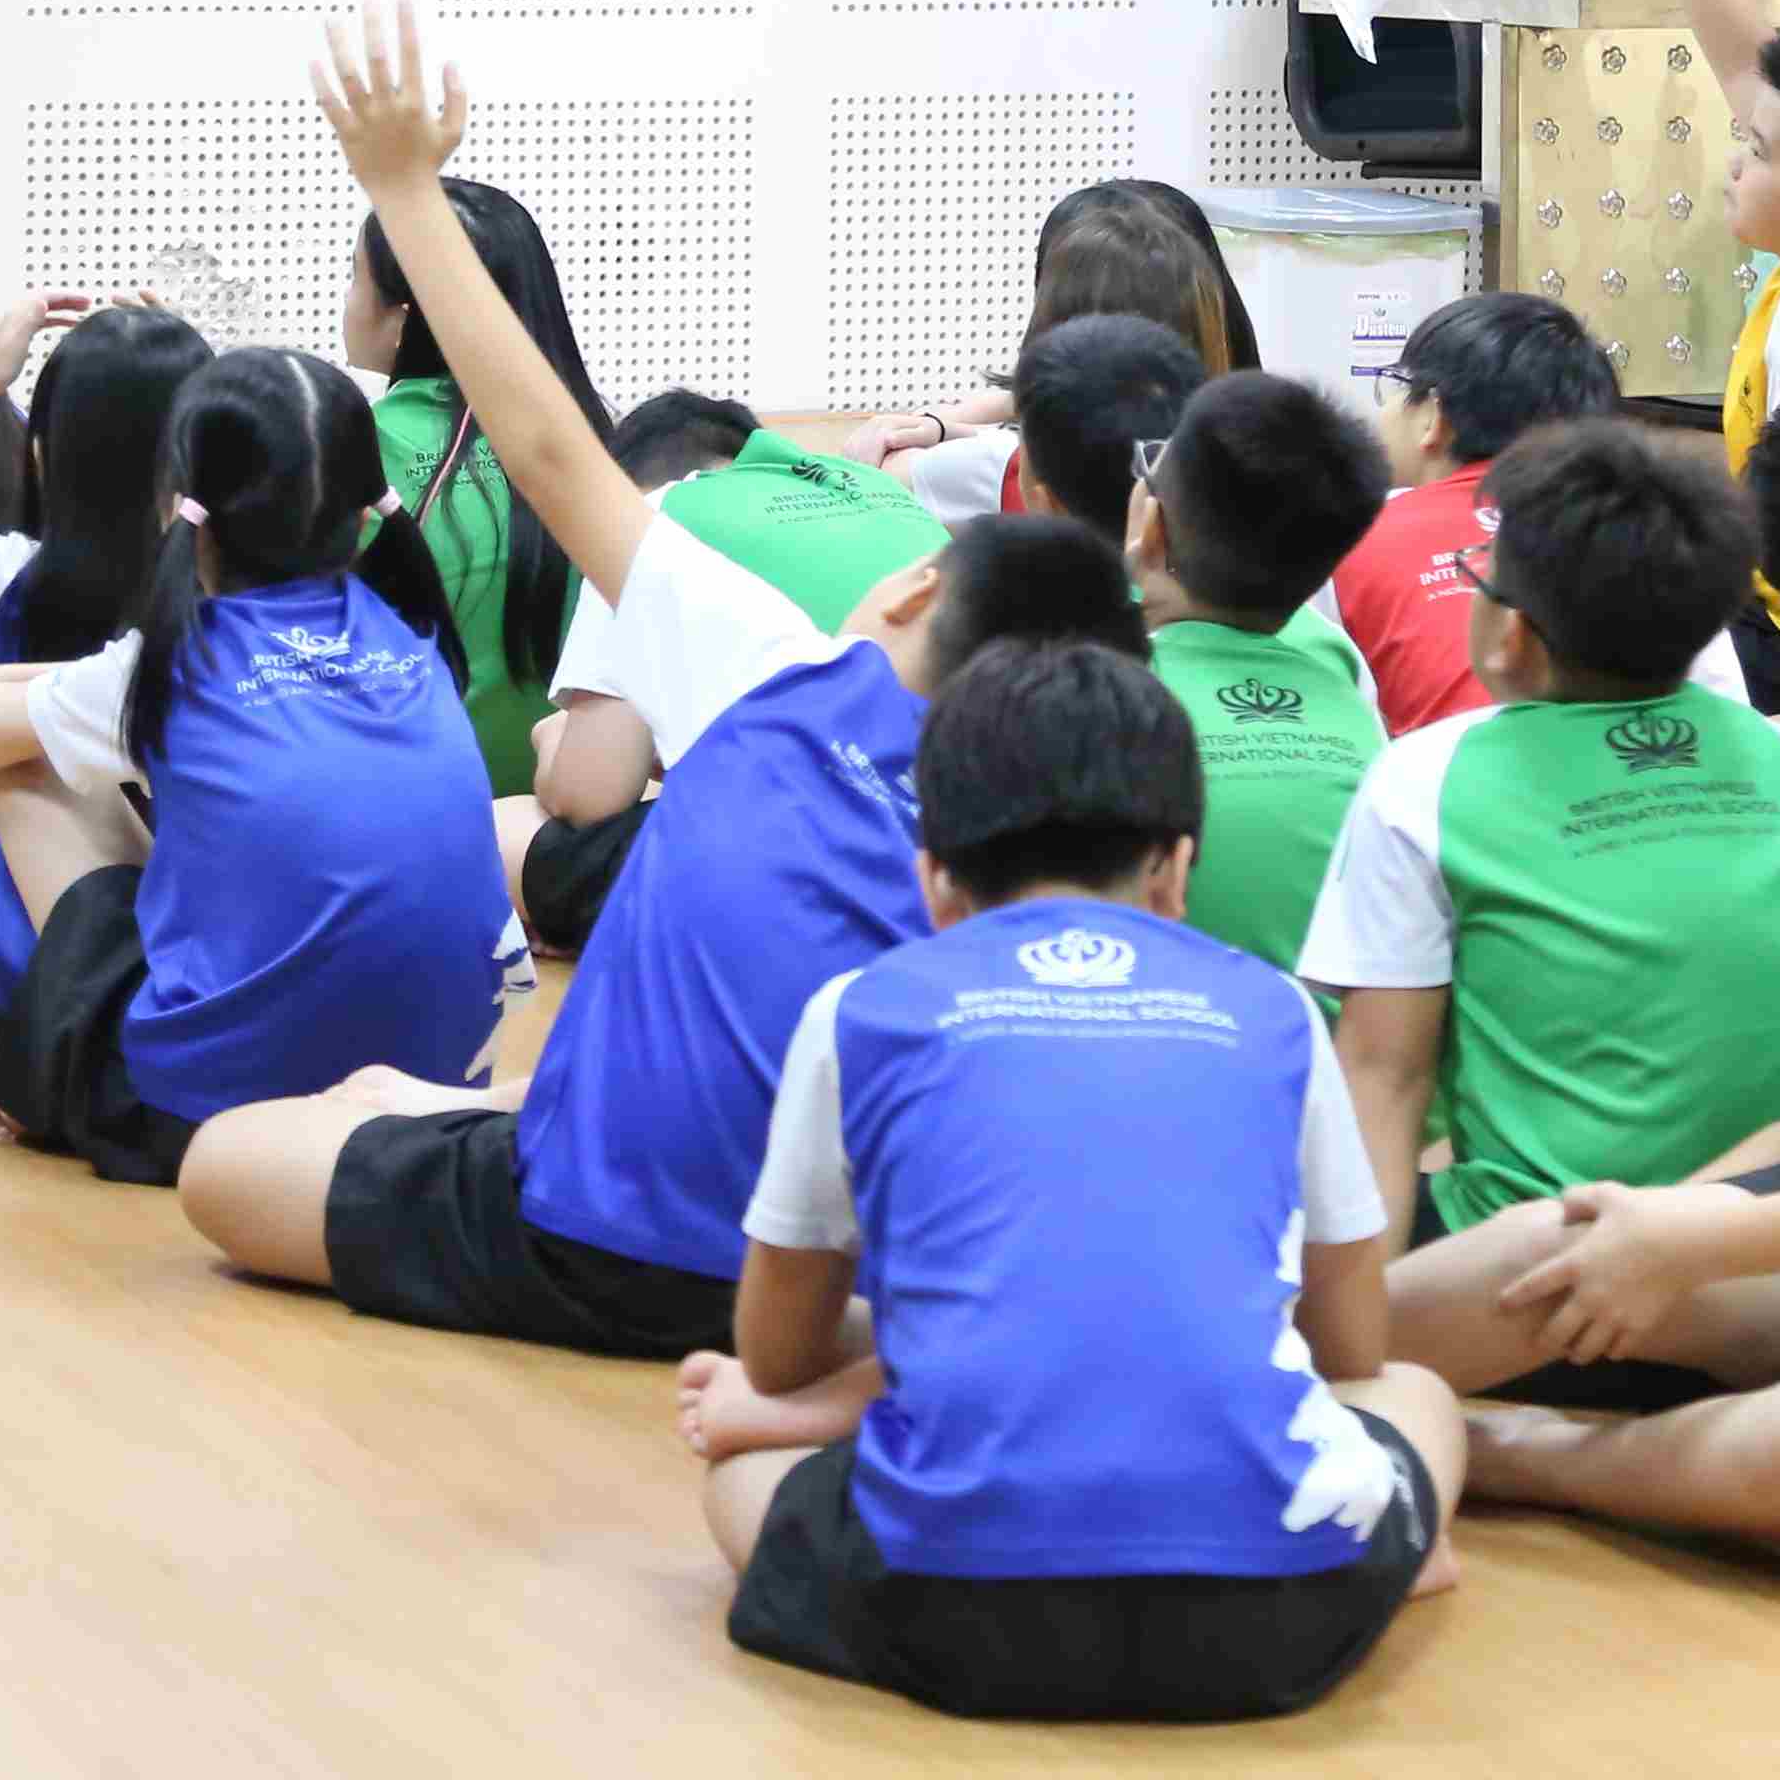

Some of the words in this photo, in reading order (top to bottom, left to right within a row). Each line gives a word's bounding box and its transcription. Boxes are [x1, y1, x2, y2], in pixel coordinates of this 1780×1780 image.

[1568, 789, 1645, 815] BRITISH
[1647, 780, 1757, 799] VIETNAMESE
[1561, 801, 1718, 838] INTERNATIONAL
[955, 987, 1051, 1008] BRITISH
[1052, 987, 1210, 1008] VIETNAMESE
[935, 1003, 1135, 1029] INTERNATIONAL
[1138, 1005, 1240, 1031] SCHOOL
